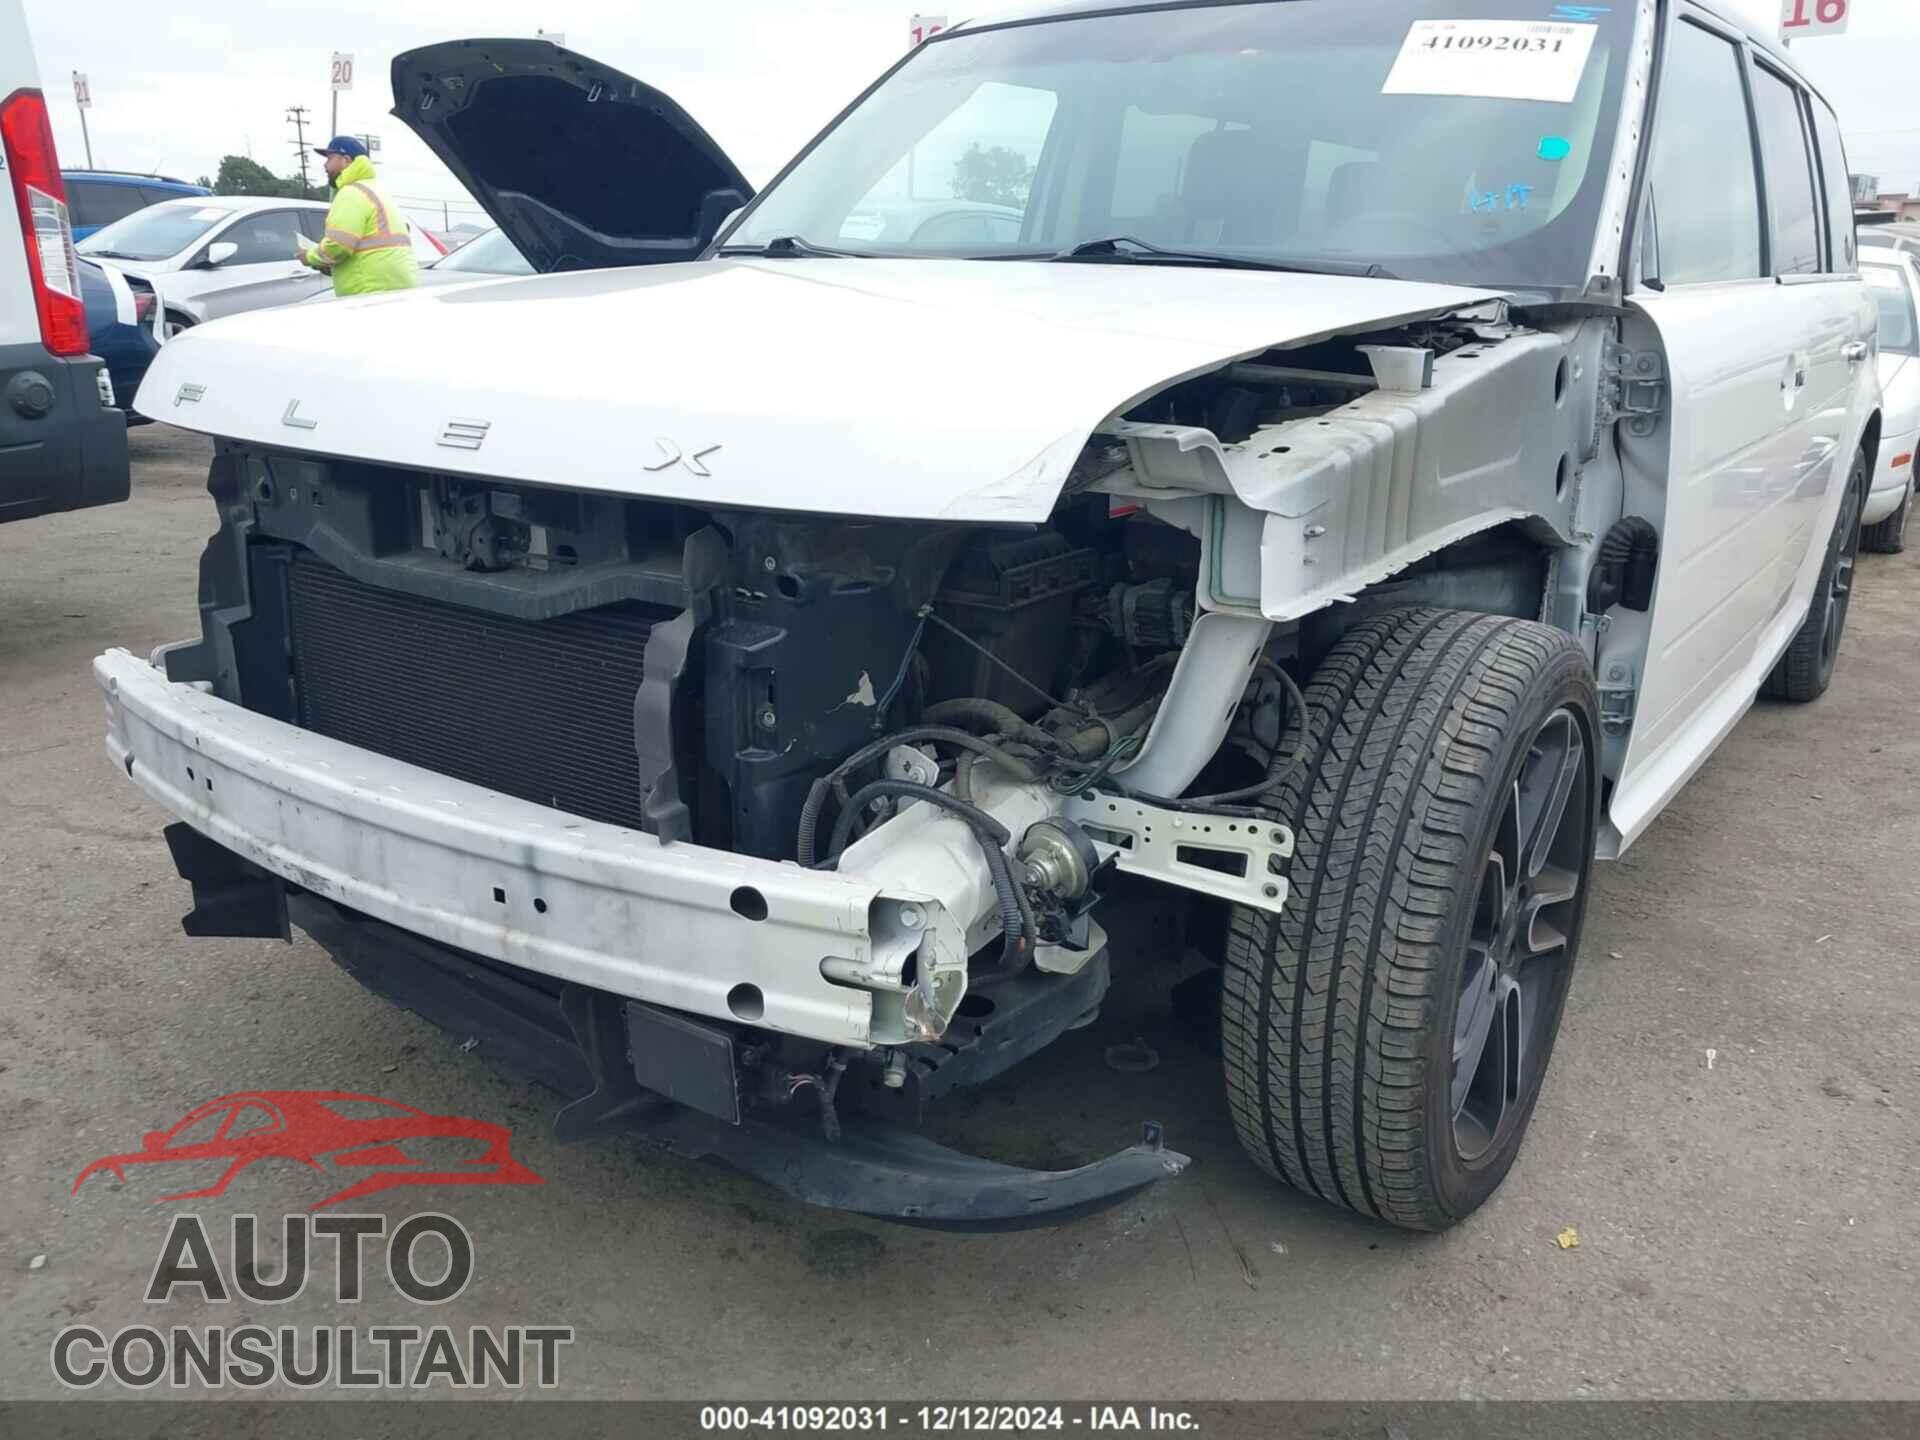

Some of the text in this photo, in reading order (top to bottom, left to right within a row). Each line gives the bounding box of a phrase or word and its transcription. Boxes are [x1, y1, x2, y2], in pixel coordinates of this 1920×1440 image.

[911, 25, 943, 44] 1
[1421, 35, 1564, 53] 41092031
[331, 60, 353, 84] 20
[74, 81, 91, 103] 21
